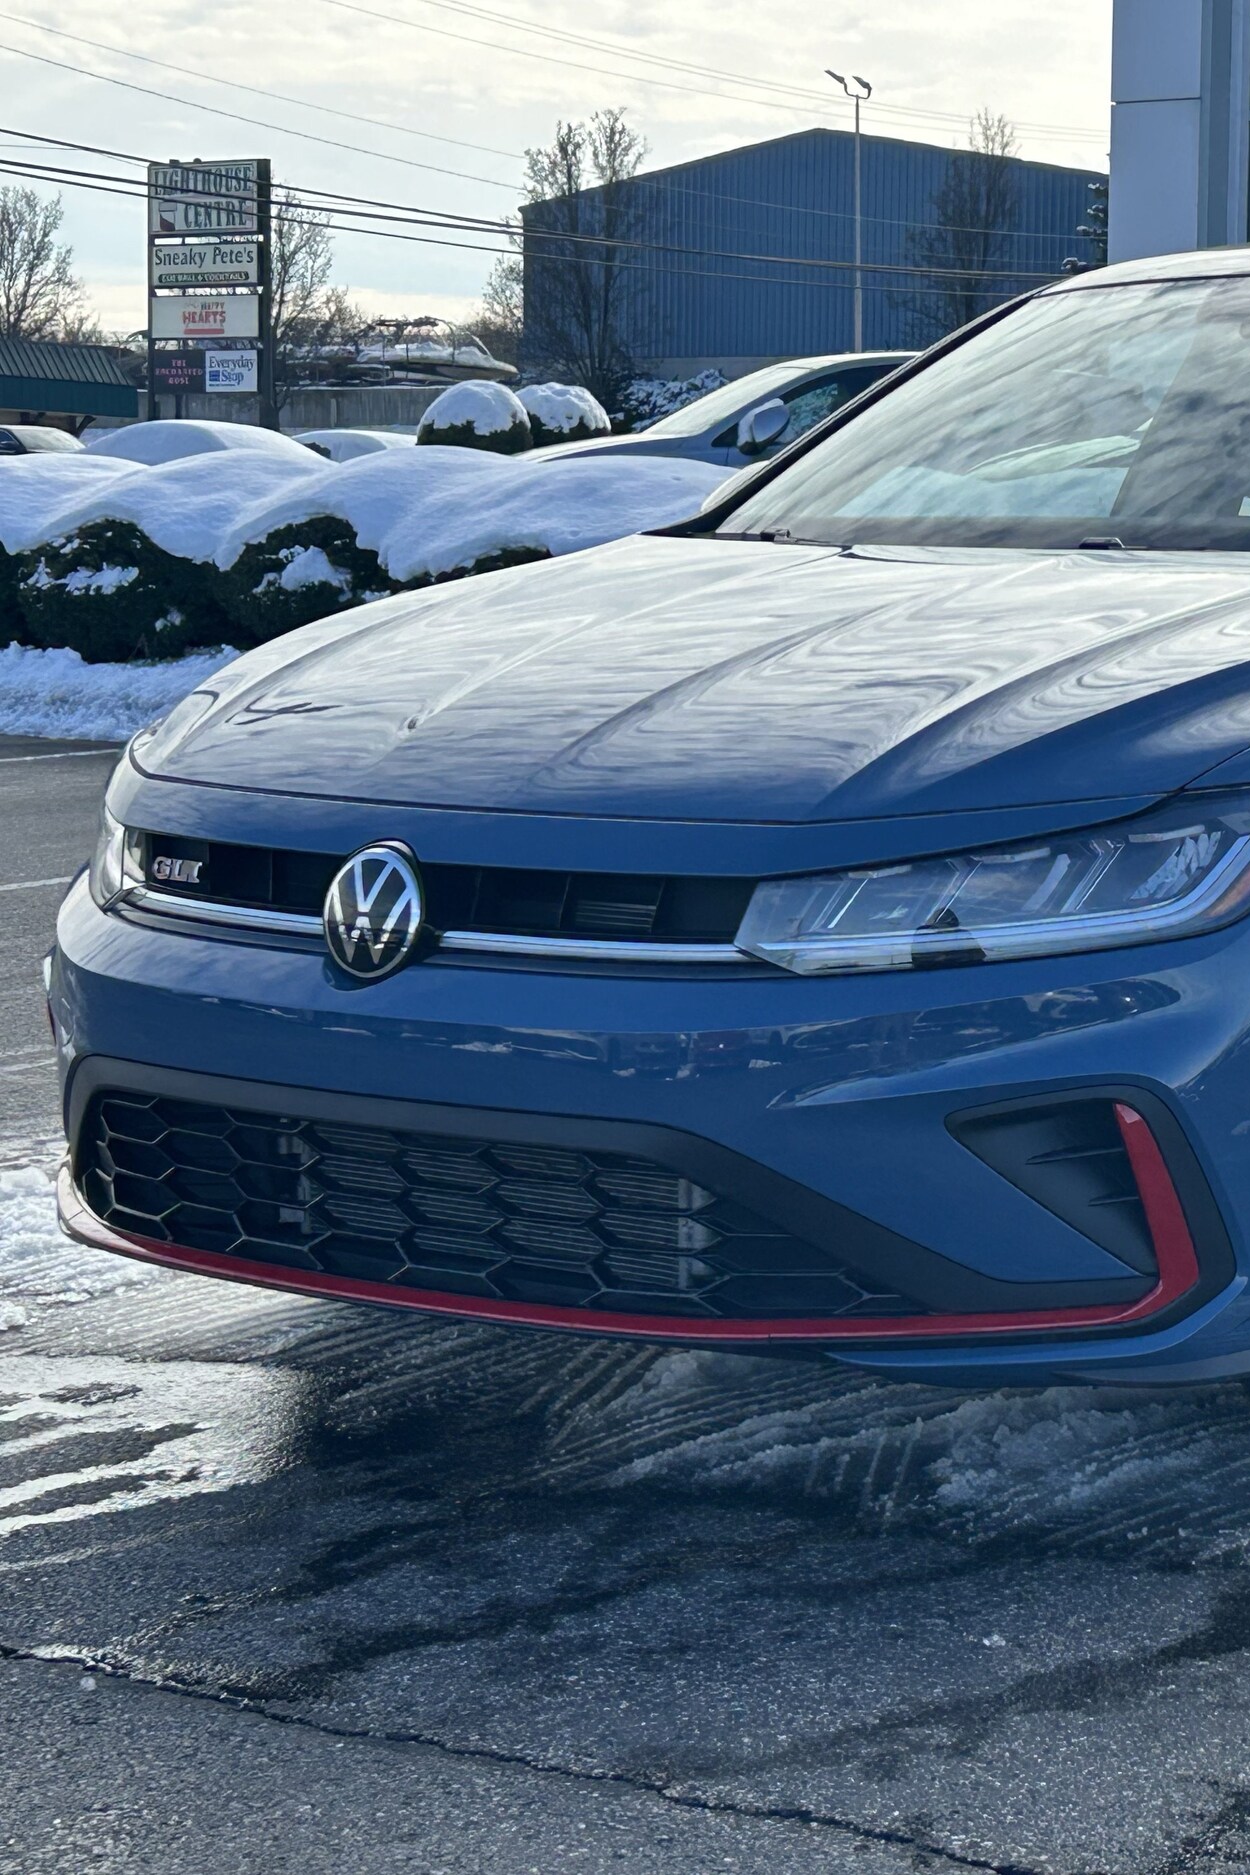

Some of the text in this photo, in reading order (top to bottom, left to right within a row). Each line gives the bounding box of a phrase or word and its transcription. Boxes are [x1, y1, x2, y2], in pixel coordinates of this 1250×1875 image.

[154, 166, 252, 196] LIGHTHOUSE
[184, 201, 247, 229] CENTRE
[155, 246, 254, 269] Sneaky Pete's
[182, 311, 226, 325] HEARTS
[209, 355, 255, 372] Everyday
[221, 370, 244, 385] Stop
[152, 856, 203, 884] GLI
